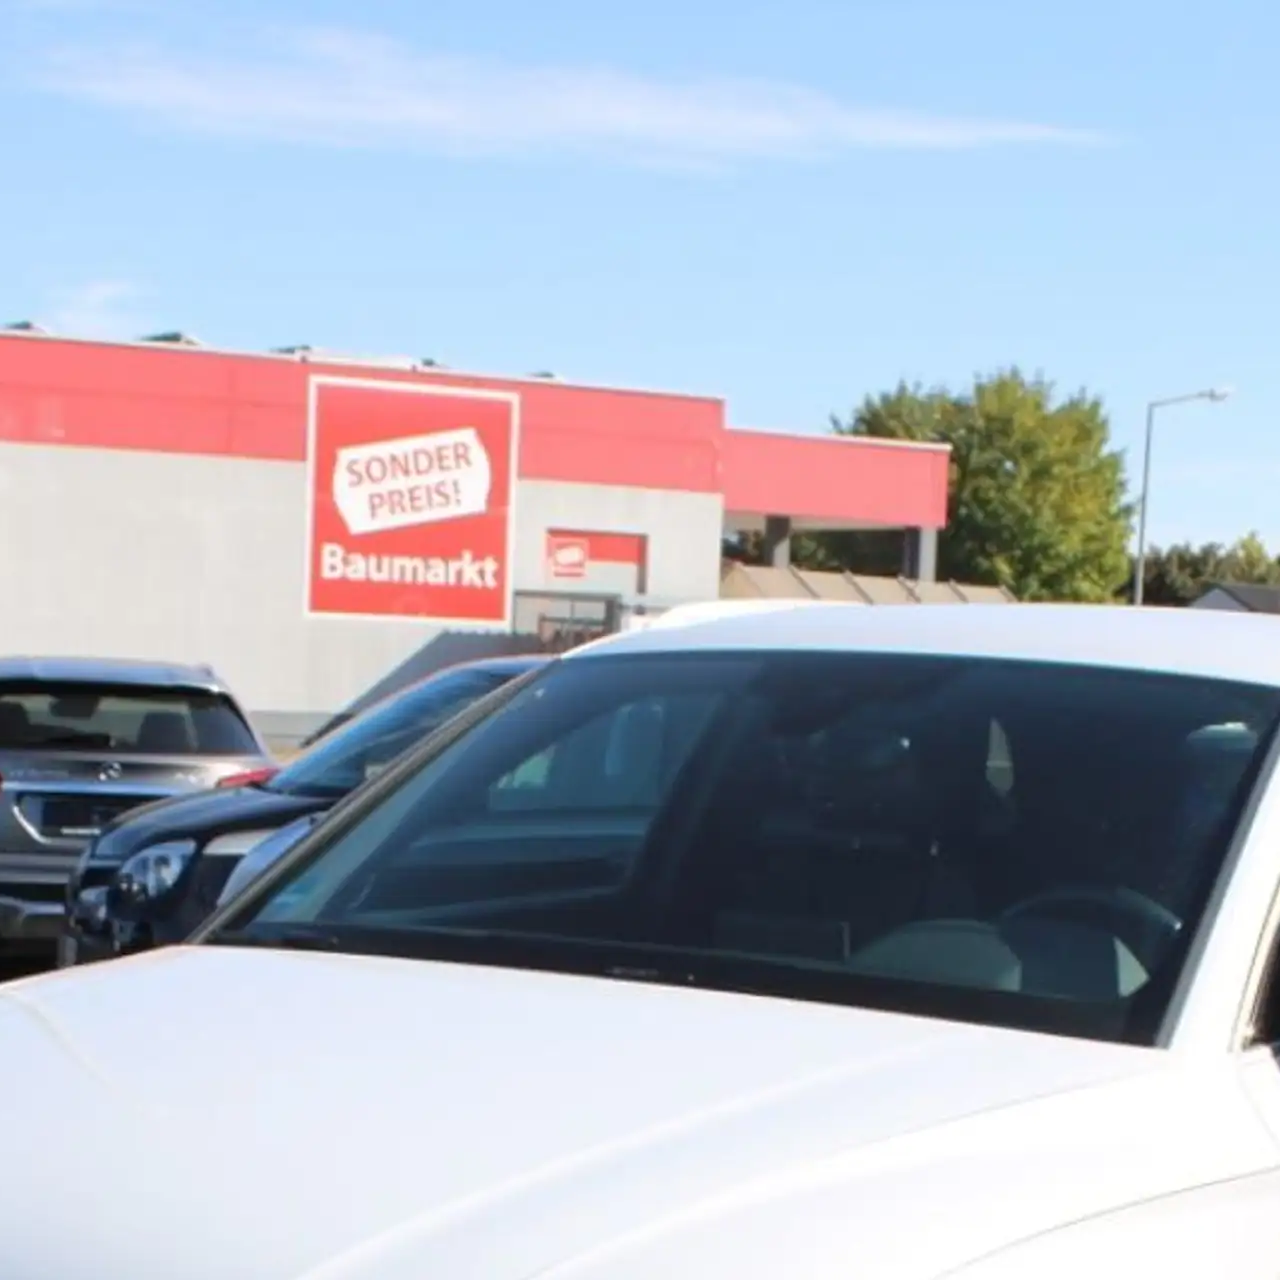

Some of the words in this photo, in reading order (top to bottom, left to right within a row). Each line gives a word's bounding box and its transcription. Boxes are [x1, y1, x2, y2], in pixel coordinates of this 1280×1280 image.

[346, 441, 472, 488] SONDER
[368, 480, 461, 519] PREIS!
[322, 542, 498, 589] Baumarkt
